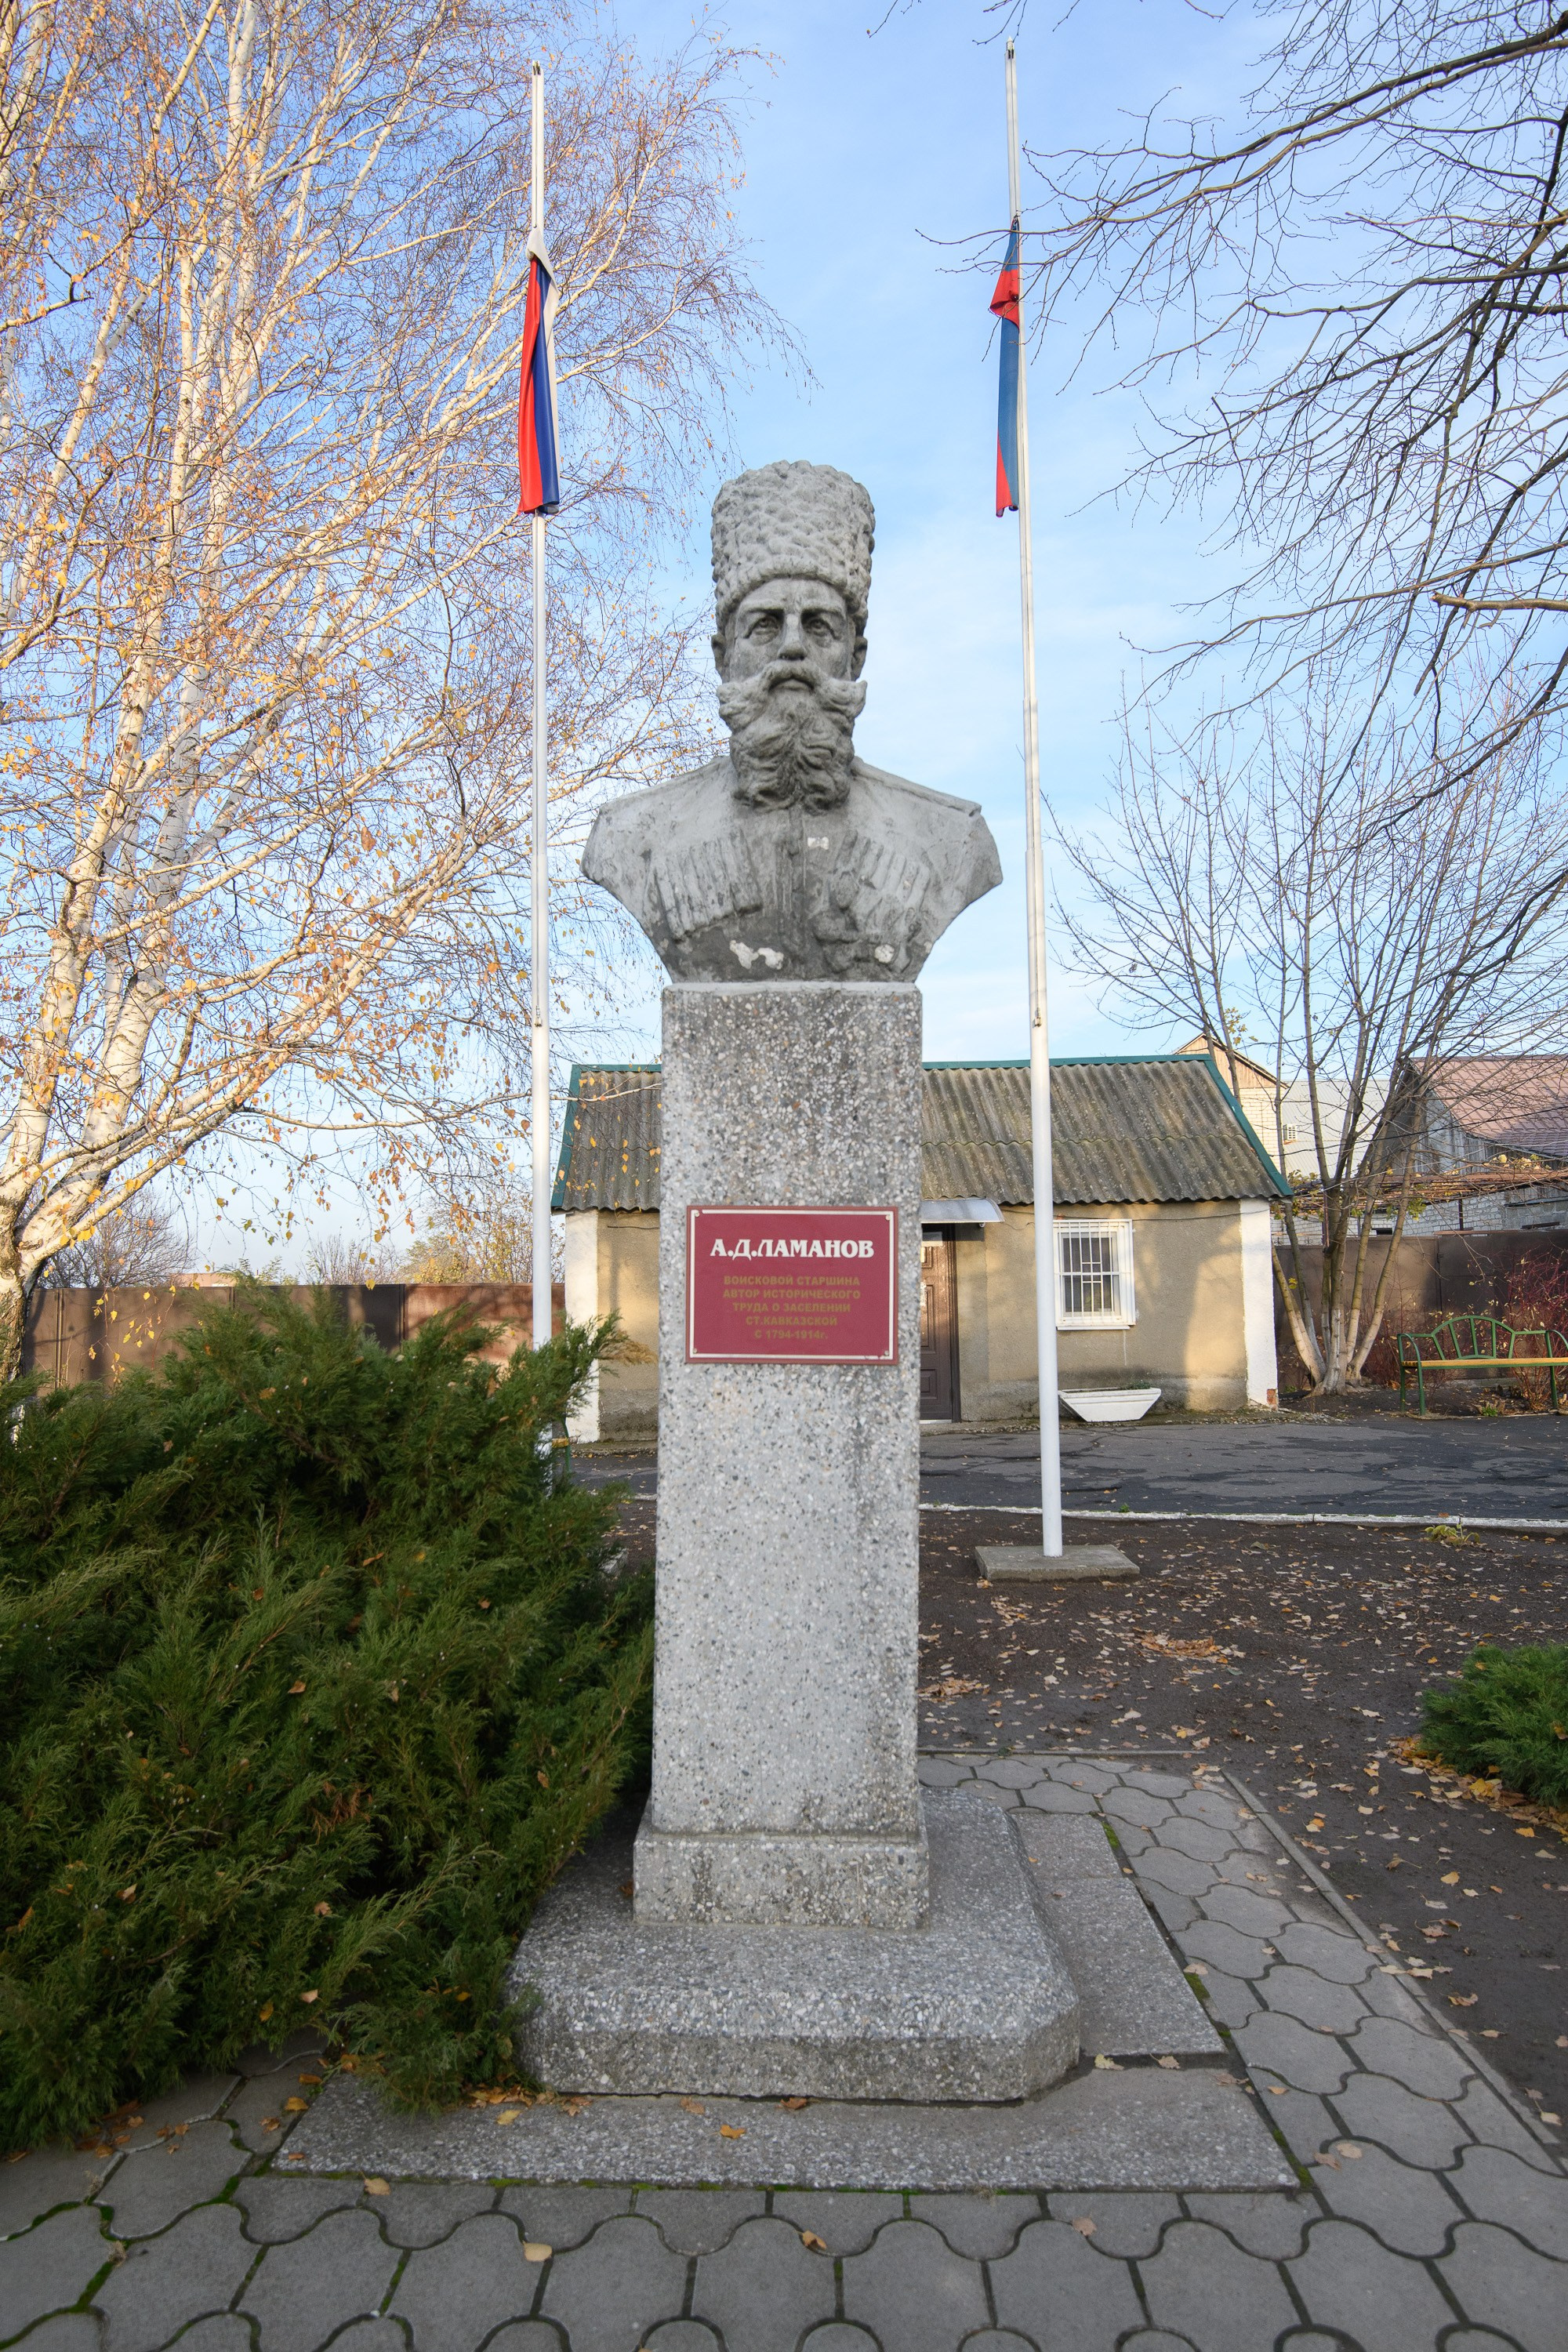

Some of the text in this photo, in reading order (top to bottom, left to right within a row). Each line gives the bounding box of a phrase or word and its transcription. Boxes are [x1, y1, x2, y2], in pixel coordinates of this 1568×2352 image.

[710, 1239, 874, 1260] А.Д.ЛАМАНОВ
[797, 1276, 860, 1286] СТАРШИНА
[723, 1290, 861, 1299] АВТОР ИСТОРИЧЕСКОГО
[732, 1303, 851, 1312] ТРУДА О ЗАСЕЛЕНИИ
[754, 1330, 762, 1339] С
